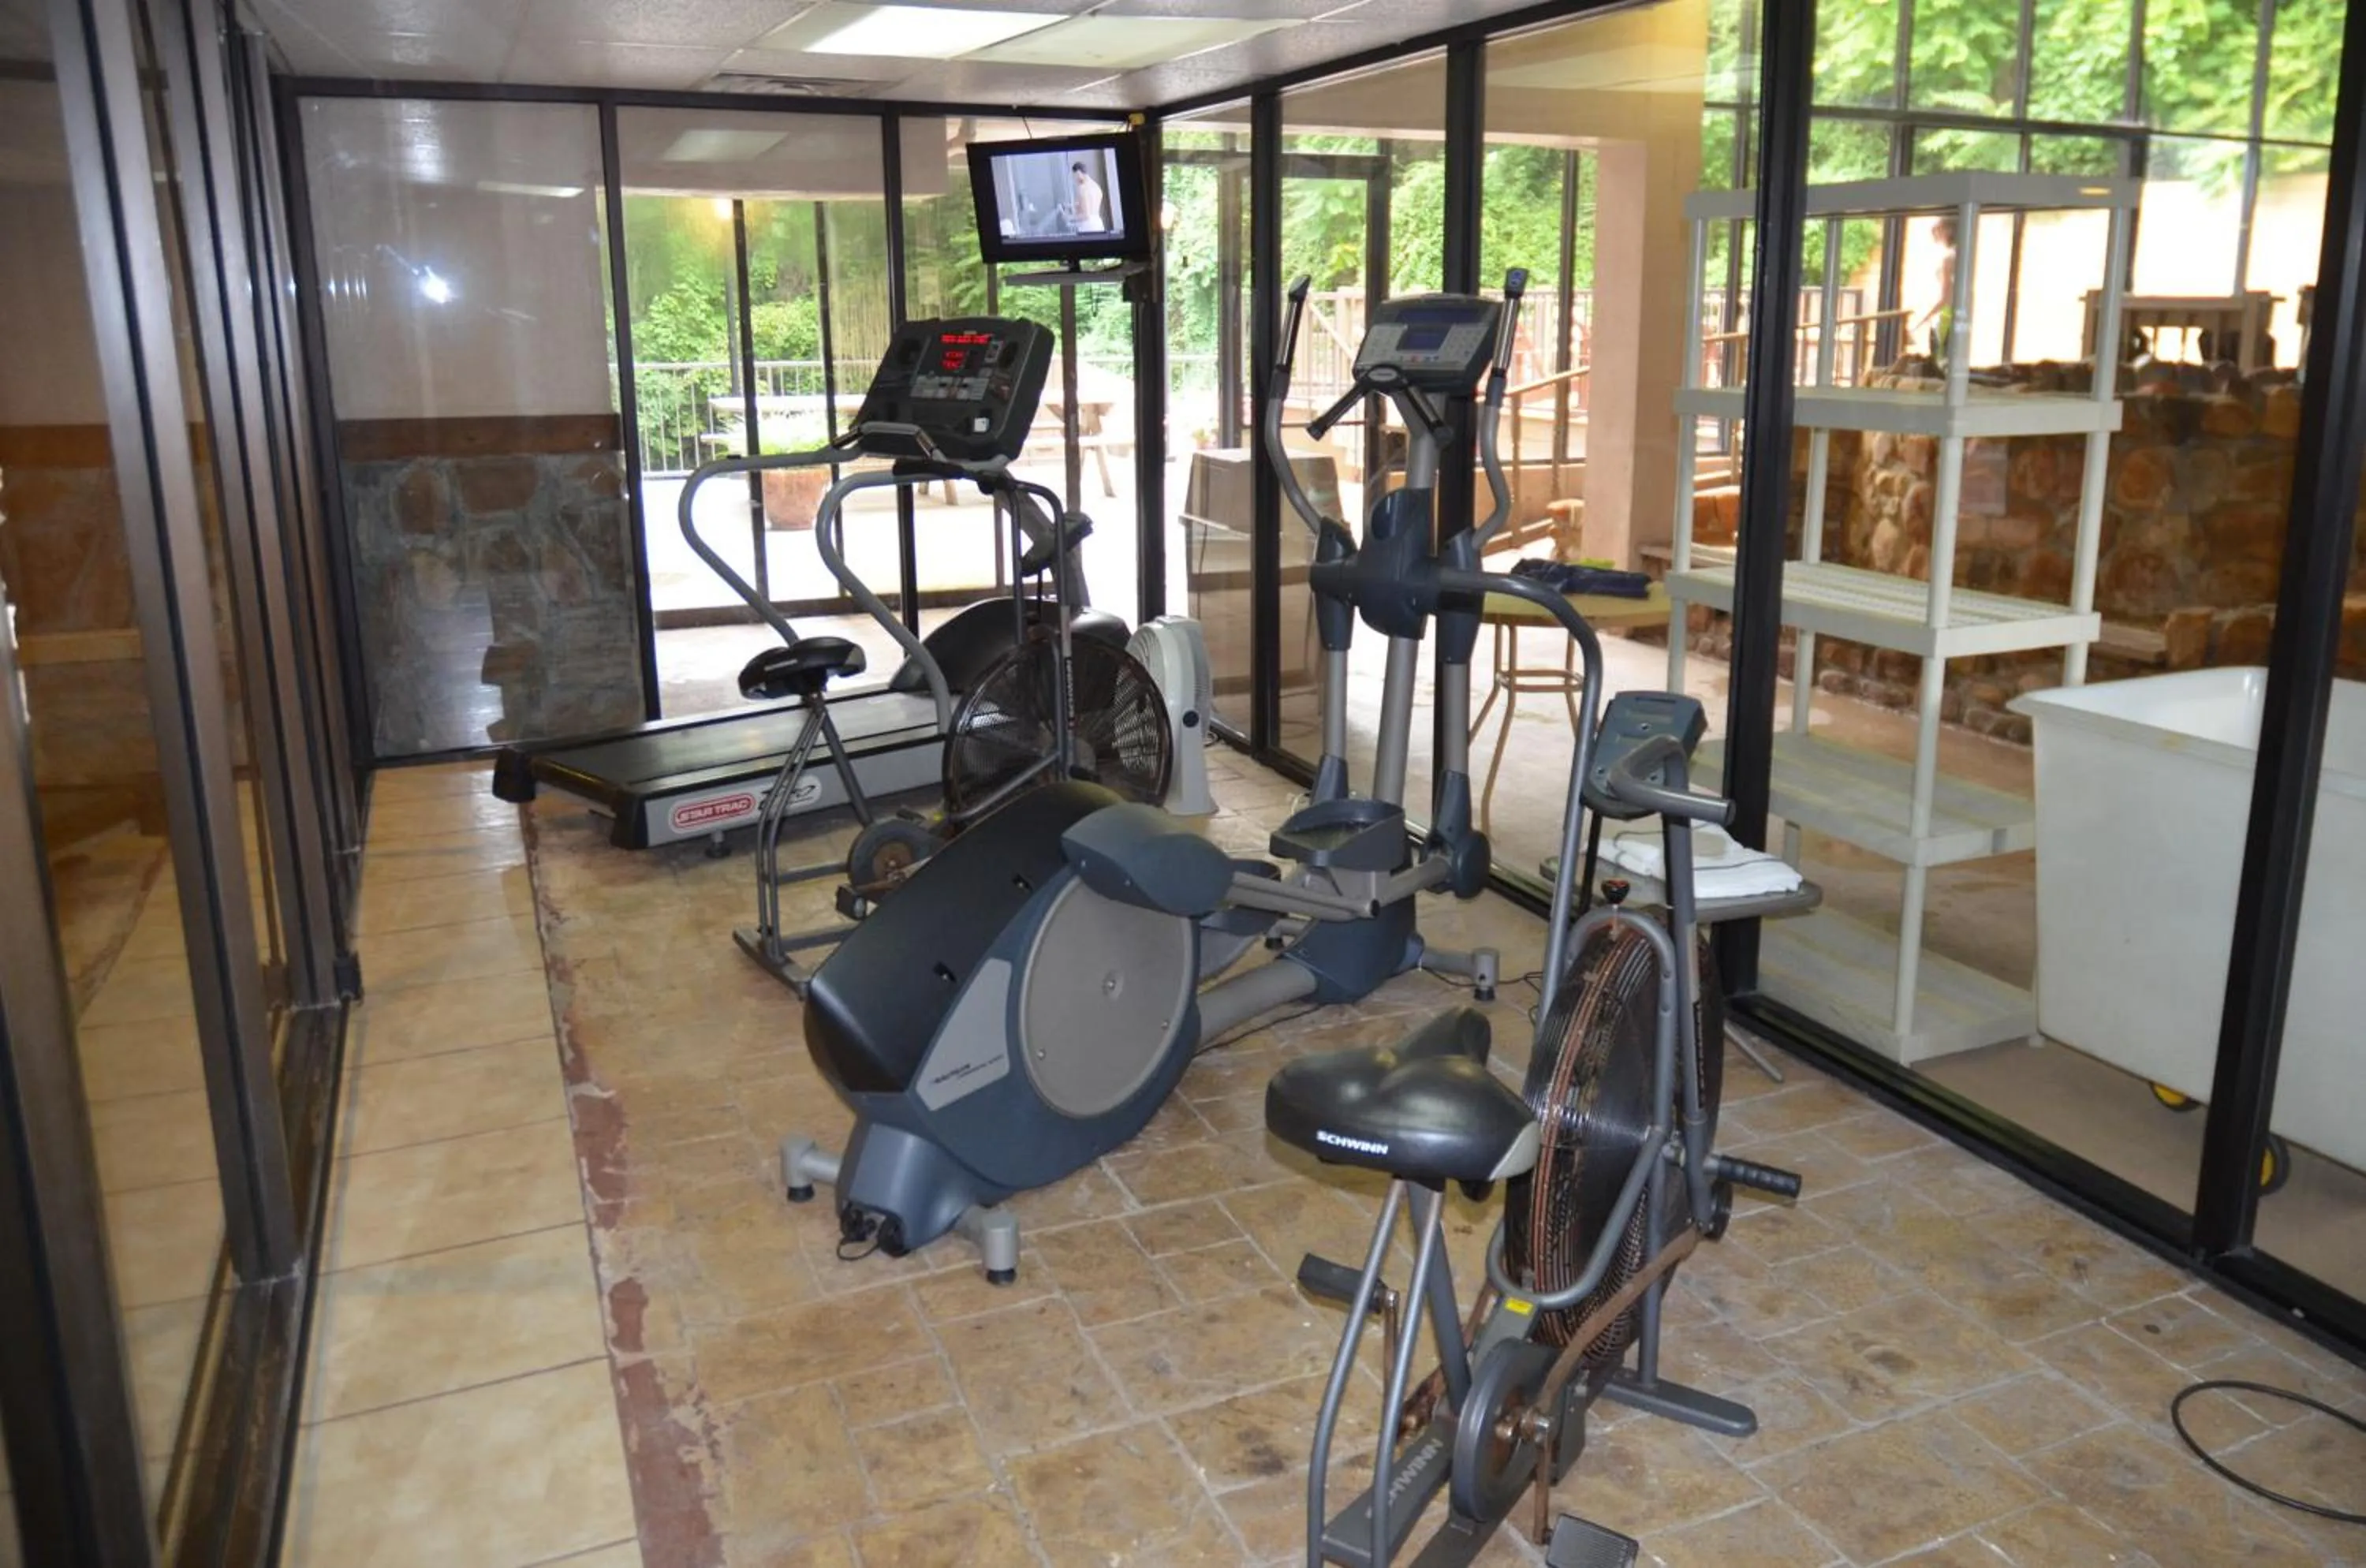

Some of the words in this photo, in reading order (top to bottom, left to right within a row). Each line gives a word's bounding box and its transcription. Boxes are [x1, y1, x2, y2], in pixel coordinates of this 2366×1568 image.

[712, 798, 748, 816] TRAC
[1315, 1129, 1389, 1155] SCHWINN
[1365, 1438, 1444, 1519] HWINN
